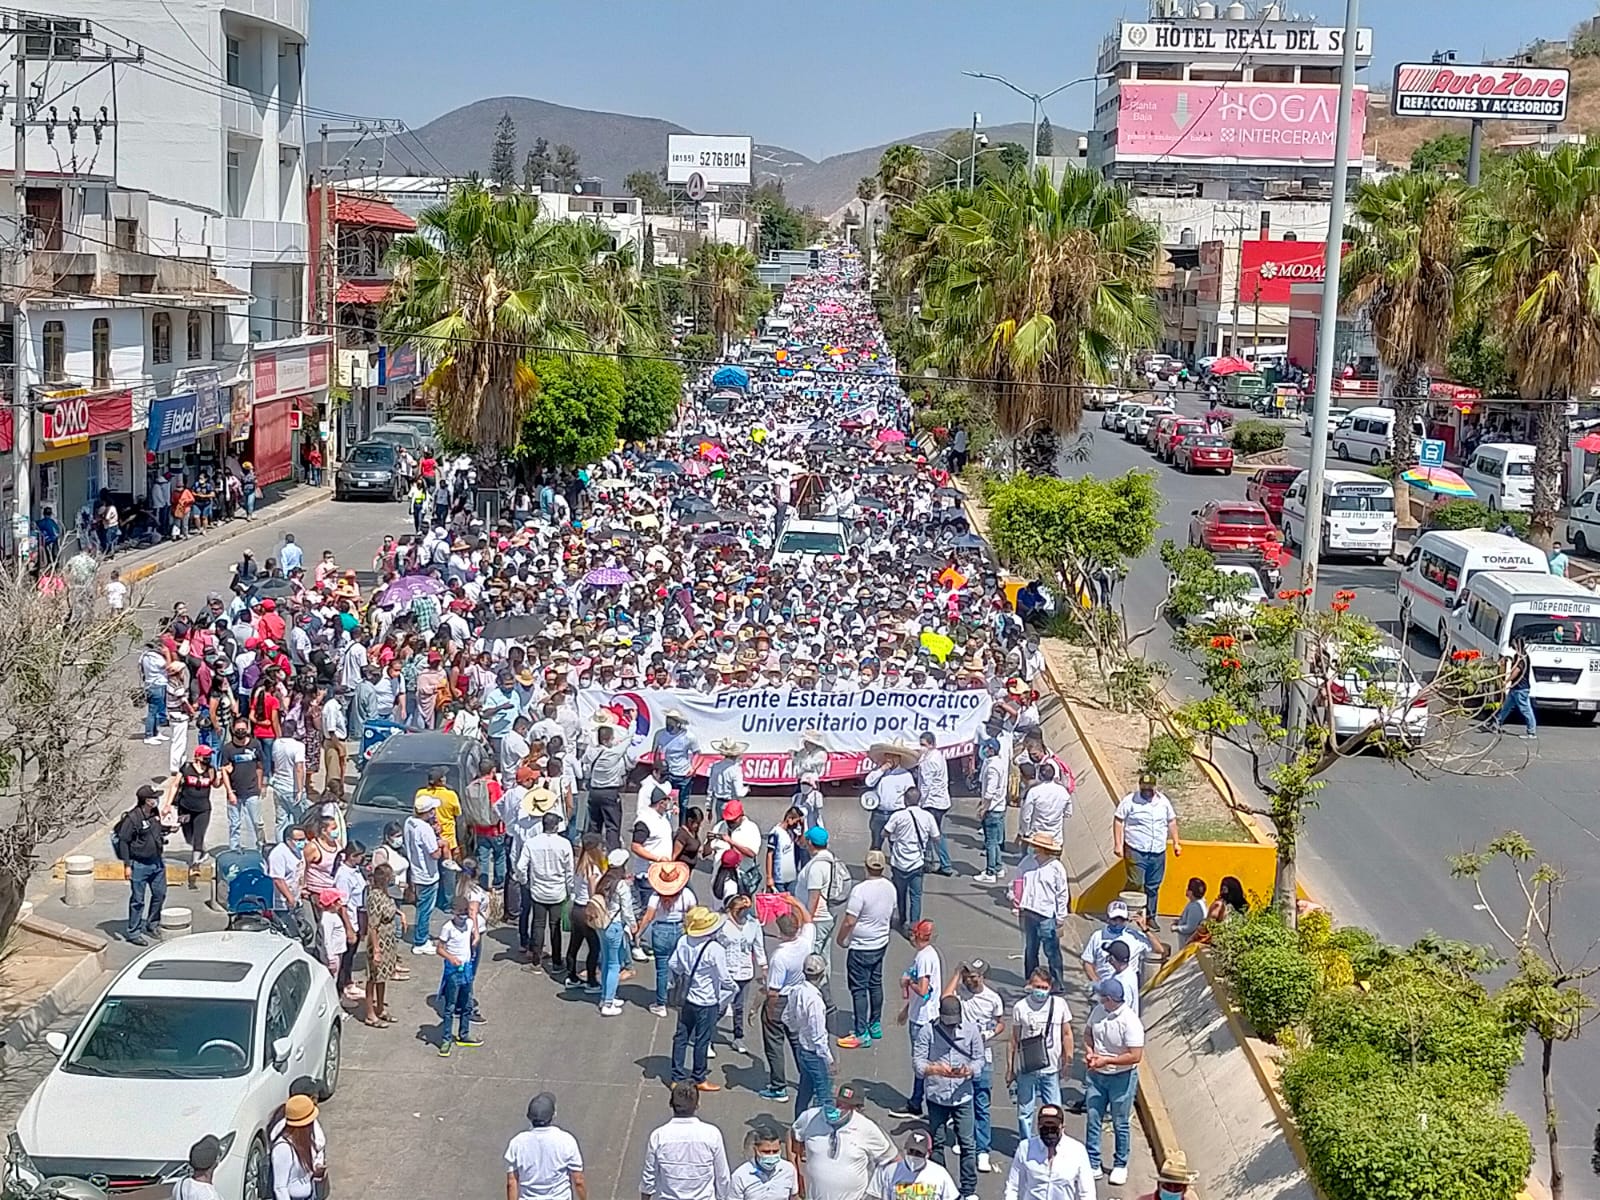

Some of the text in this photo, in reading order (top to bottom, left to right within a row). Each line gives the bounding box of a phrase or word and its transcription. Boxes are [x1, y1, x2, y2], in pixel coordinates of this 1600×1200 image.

[1156, 27, 1364, 52] HOTEL REAL DEL SL
[1427, 69, 1566, 98] AutoZone
[1403, 96, 1560, 114] REFACCIONES Y ACCESORIOS
[1133, 112, 1152, 122] Baja
[699, 151, 746, 167] 52768104
[54, 398, 89, 435] OXXO
[1482, 555, 1534, 565] TOMATAL
[1529, 601, 1591, 613] INDEPENDENCIA
[714, 690, 780, 709] Frente
[786, 690, 854, 708] Estatal
[741, 712, 960, 735] Universitario por la 4T
[744, 759, 779, 780] SIGA
